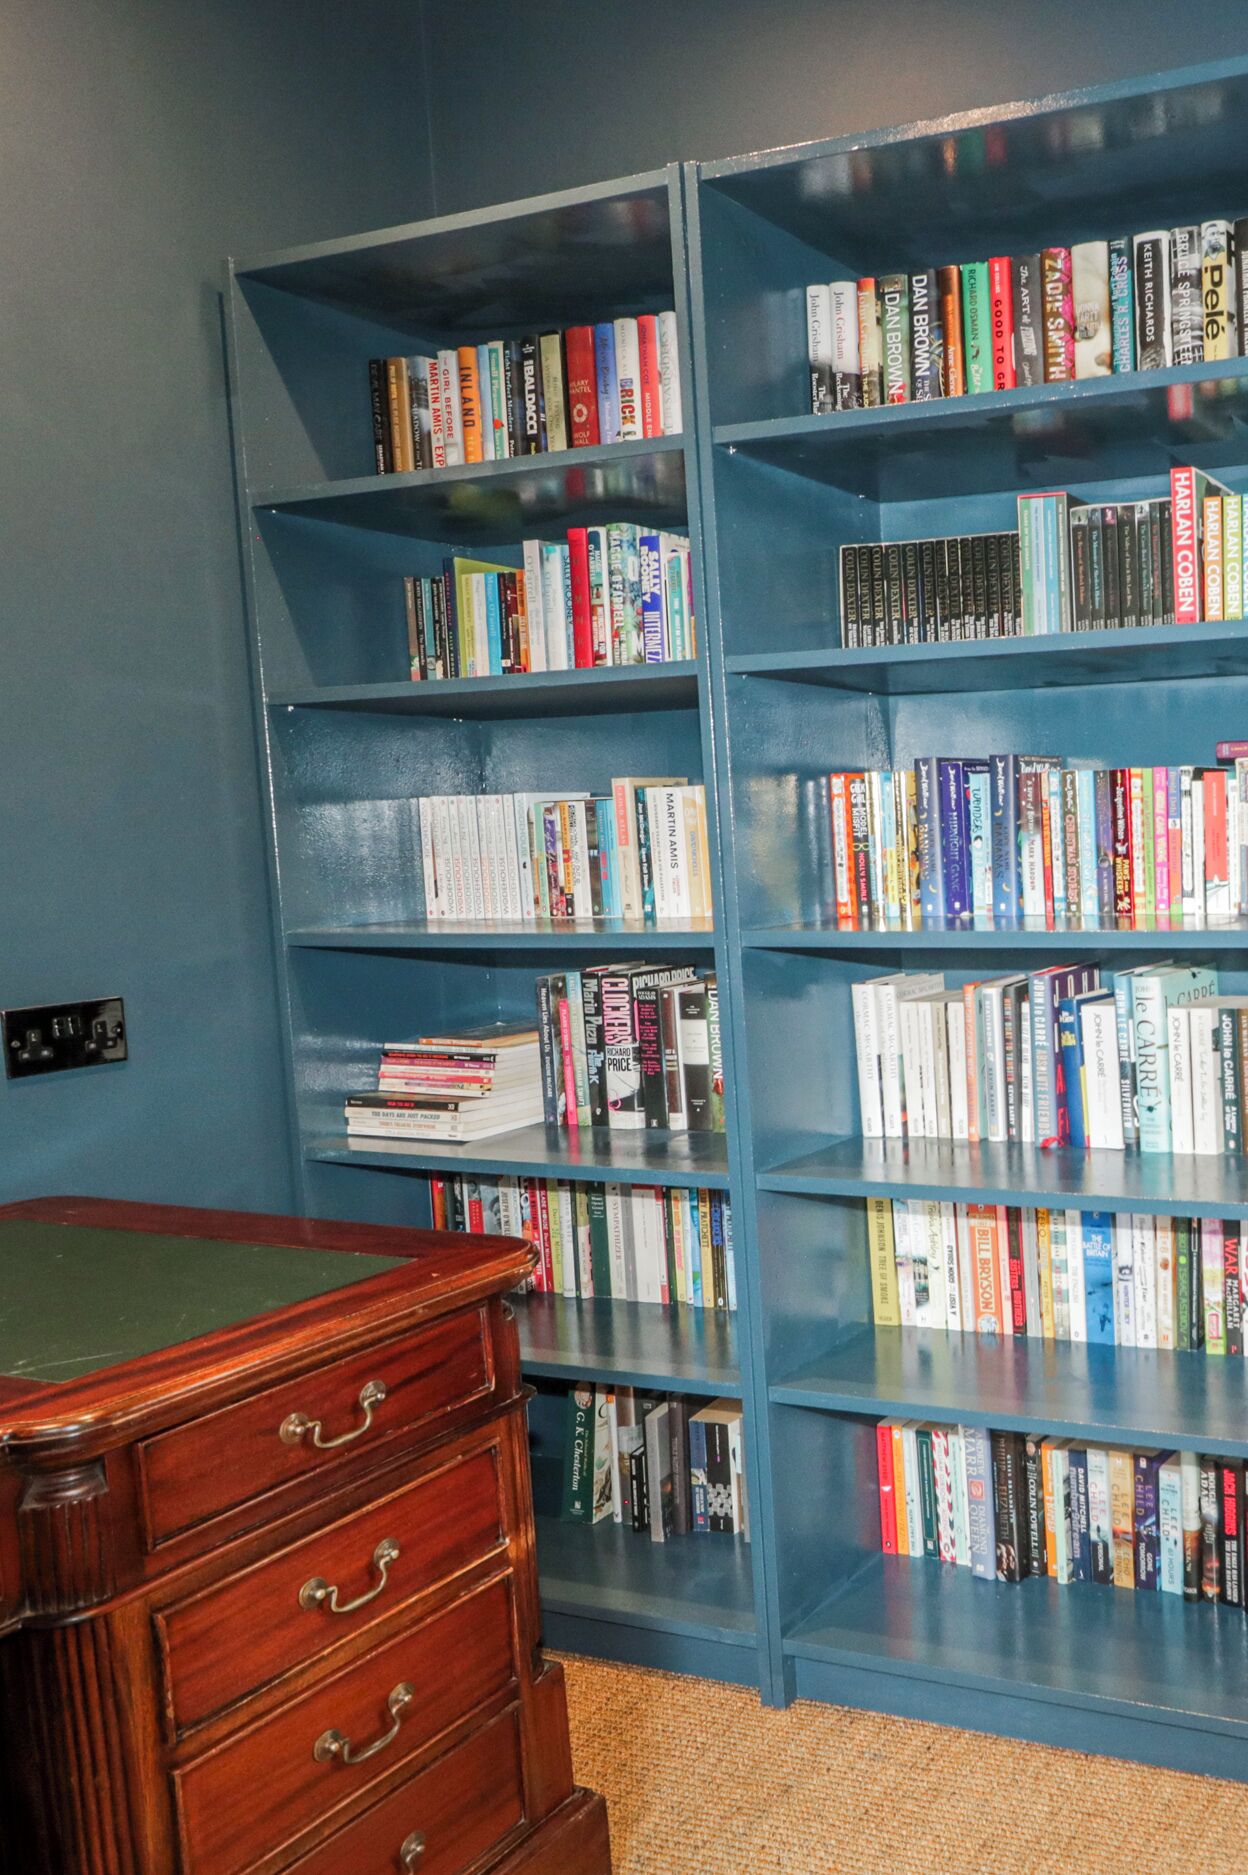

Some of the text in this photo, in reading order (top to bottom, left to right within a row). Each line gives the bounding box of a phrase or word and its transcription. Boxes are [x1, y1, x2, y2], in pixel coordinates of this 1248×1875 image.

[968, 268, 979, 342] RICHARD OSMAN
[1143, 243, 1155, 342] KEITH RICHARDS
[1203, 264, 1225, 340] Pelé
[809, 294, 821, 362] John Grisham
[833, 291, 844, 360] John Grisham
[885, 293, 904, 394] DAN BROWN
[911, 274, 932, 377] DAN BROWN
[1045, 258, 1067, 380] ZADIE SMITH
[429, 362, 440, 404] MARTIN
[504, 350, 512, 370] Eight
[432, 408, 443, 434] AMIS
[460, 366, 476, 428] INLAND
[523, 366, 537, 435] BALDACCI
[1174, 472, 1195, 612] HARLAN COBEN
[1206, 501, 1221, 615] HARLAN COBEN
[1225, 498, 1240, 613] HARLAN COBEN
[526, 556, 536, 603] O'Farrell
[610, 531, 624, 630] MAGGIE O'FARRELL
[640, 546, 650, 603] ROONEY
[649, 550, 660, 594] SALLY
[873, 548, 883, 619] COLIN DEXTER
[889, 548, 900, 619] COLIN DEXTER
[905, 546, 917, 618] COLIN DEXTER
[564, 585, 573, 625] ROONEY
[638, 814, 646, 844] McGregor
[666, 793, 679, 869] MARTIN AMIS
[851, 808, 860, 837] MISFIT
[860, 808, 868, 839] MODEL
[1066, 815, 1078, 864] CHRISTMAS
[1117, 819, 1125, 839] Wilson
[949, 811, 961, 892] MIDNIGHT GANG
[1027, 839, 1037, 891] MARK HADDON
[1116, 857, 1124, 894] WHISKERS
[444, 857, 454, 914] WODEHOUSE
[473, 857, 482, 914] WODEHOUSE
[499, 857, 509, 914] WODEHOUSE
[860, 878, 868, 903] SMALE
[540, 988, 548, 1011] Heaven
[544, 1044, 551, 1053] Us
[583, 979, 602, 1045] Mario Puzo
[601, 978, 632, 1045] CLOCKERS
[862, 991, 873, 1029] CORMAC
[985, 1000, 993, 1046] BEATLEBONE
[1136, 996, 1154, 1013] le
[594, 1051, 604, 1066] The
[606, 1048, 631, 1056] RICHARD
[707, 990, 724, 1080] DAN BROWN
[863, 1033, 874, 1080] McCARTHY
[1136, 1019, 1161, 1097] CARRÉ
[605, 1057, 632, 1072] PRICE
[1035, 1048, 1050, 1135] ABSOLUTE FRIENDS
[1120, 1080, 1133, 1128] SILVERVIEW
[501, 1190, 510, 1212] JOSEPH
[874, 1200, 887, 1252] DENIS JOHNSON
[612, 1200, 622, 1261] SYMPATHIZER
[700, 1210, 710, 1248] PRATCHETT
[976, 1228, 990, 1255] BILL
[1086, 1250, 1109, 1258] BRITAIN
[1224, 1238, 1238, 1275] WAR
[979, 1257, 994, 1310] BRYSON
[1009, 1258, 1024, 1326] SISTERS BROTHERS
[1225, 1278, 1234, 1329] MACMILLAN
[1232, 1279, 1240, 1328] MARGARET
[572, 1412, 586, 1490] G. K. Chesterton
[964, 1428, 976, 1475] MARR
[998, 1485, 1010, 1540] ELIZABETH
[1070, 1466, 1081, 1558] number9dream
[1079, 1494, 1087, 1534] MITCHELL
[1089, 1482, 1098, 1522] CHILD
[1111, 1484, 1122, 1526] CHILD
[1121, 1493, 1130, 1519] LEE
[1134, 1474, 1145, 1516] CHILD
[1161, 1498, 1170, 1537] CHILD
[1223, 1469, 1237, 1536] JACK HIGGINS
[969, 1504, 980, 1554] QUEEN
[977, 1504, 988, 1554] DIAMOND
[1138, 1542, 1146, 1581] TOMORROW
